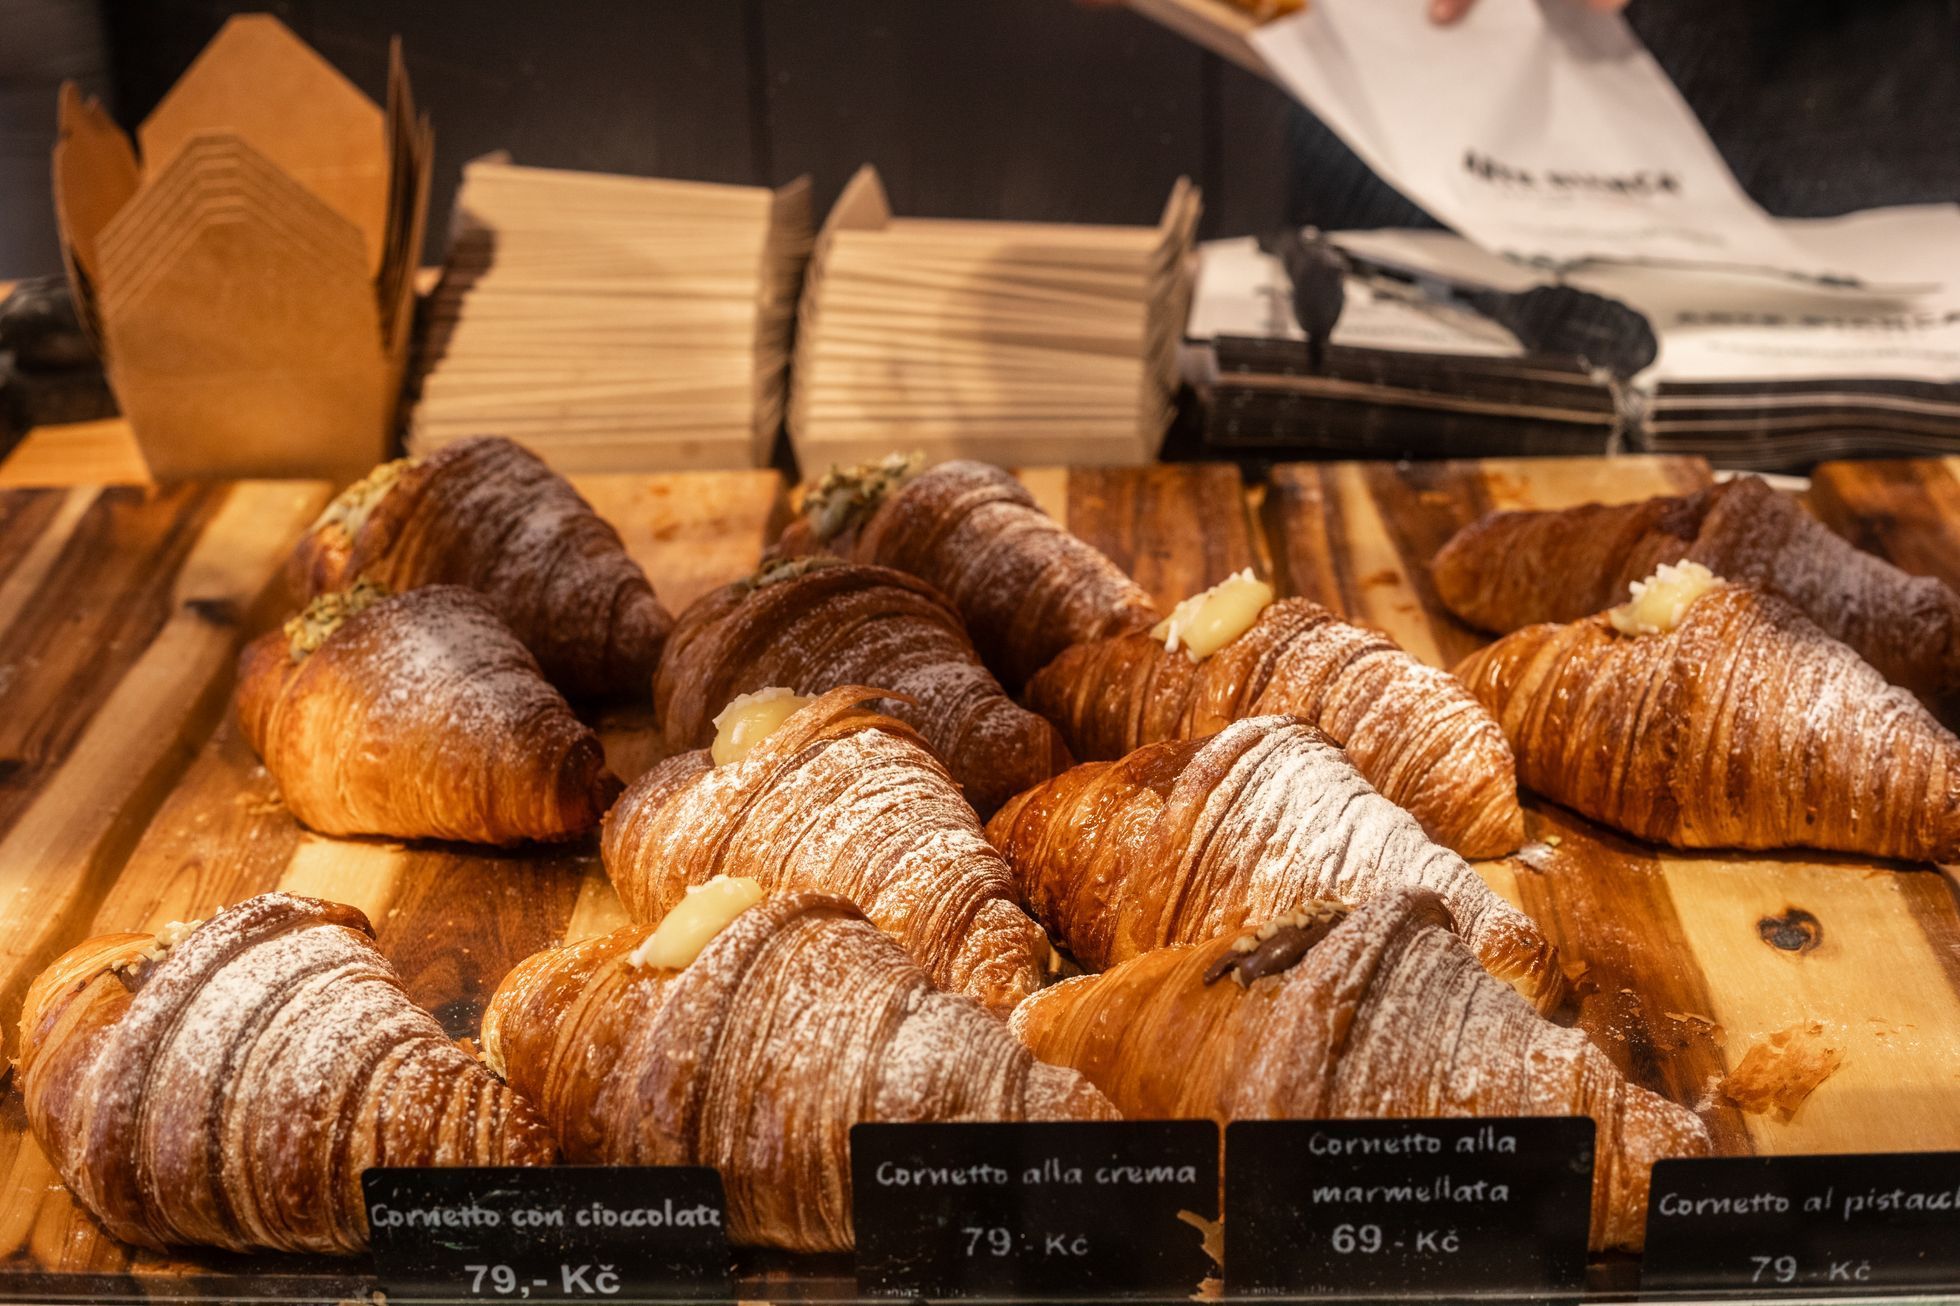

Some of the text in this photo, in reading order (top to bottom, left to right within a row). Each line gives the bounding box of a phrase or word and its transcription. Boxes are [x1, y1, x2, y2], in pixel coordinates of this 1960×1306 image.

[1308, 1125, 1517, 1156] Cornetto alla
[876, 1157, 1197, 1186] Cornetto alla crema
[1312, 1175, 1509, 1203] marmellata
[1658, 1192, 1790, 1216] Cornetto
[1804, 1186, 1833, 1212] al
[371, 1202, 501, 1228] Cornetto
[511, 1207, 564, 1228] con
[1415, 1229, 1460, 1253] Kč
[464, 1264, 621, 1298] 79,- Kč
[1828, 1259, 1872, 1281] Kč
